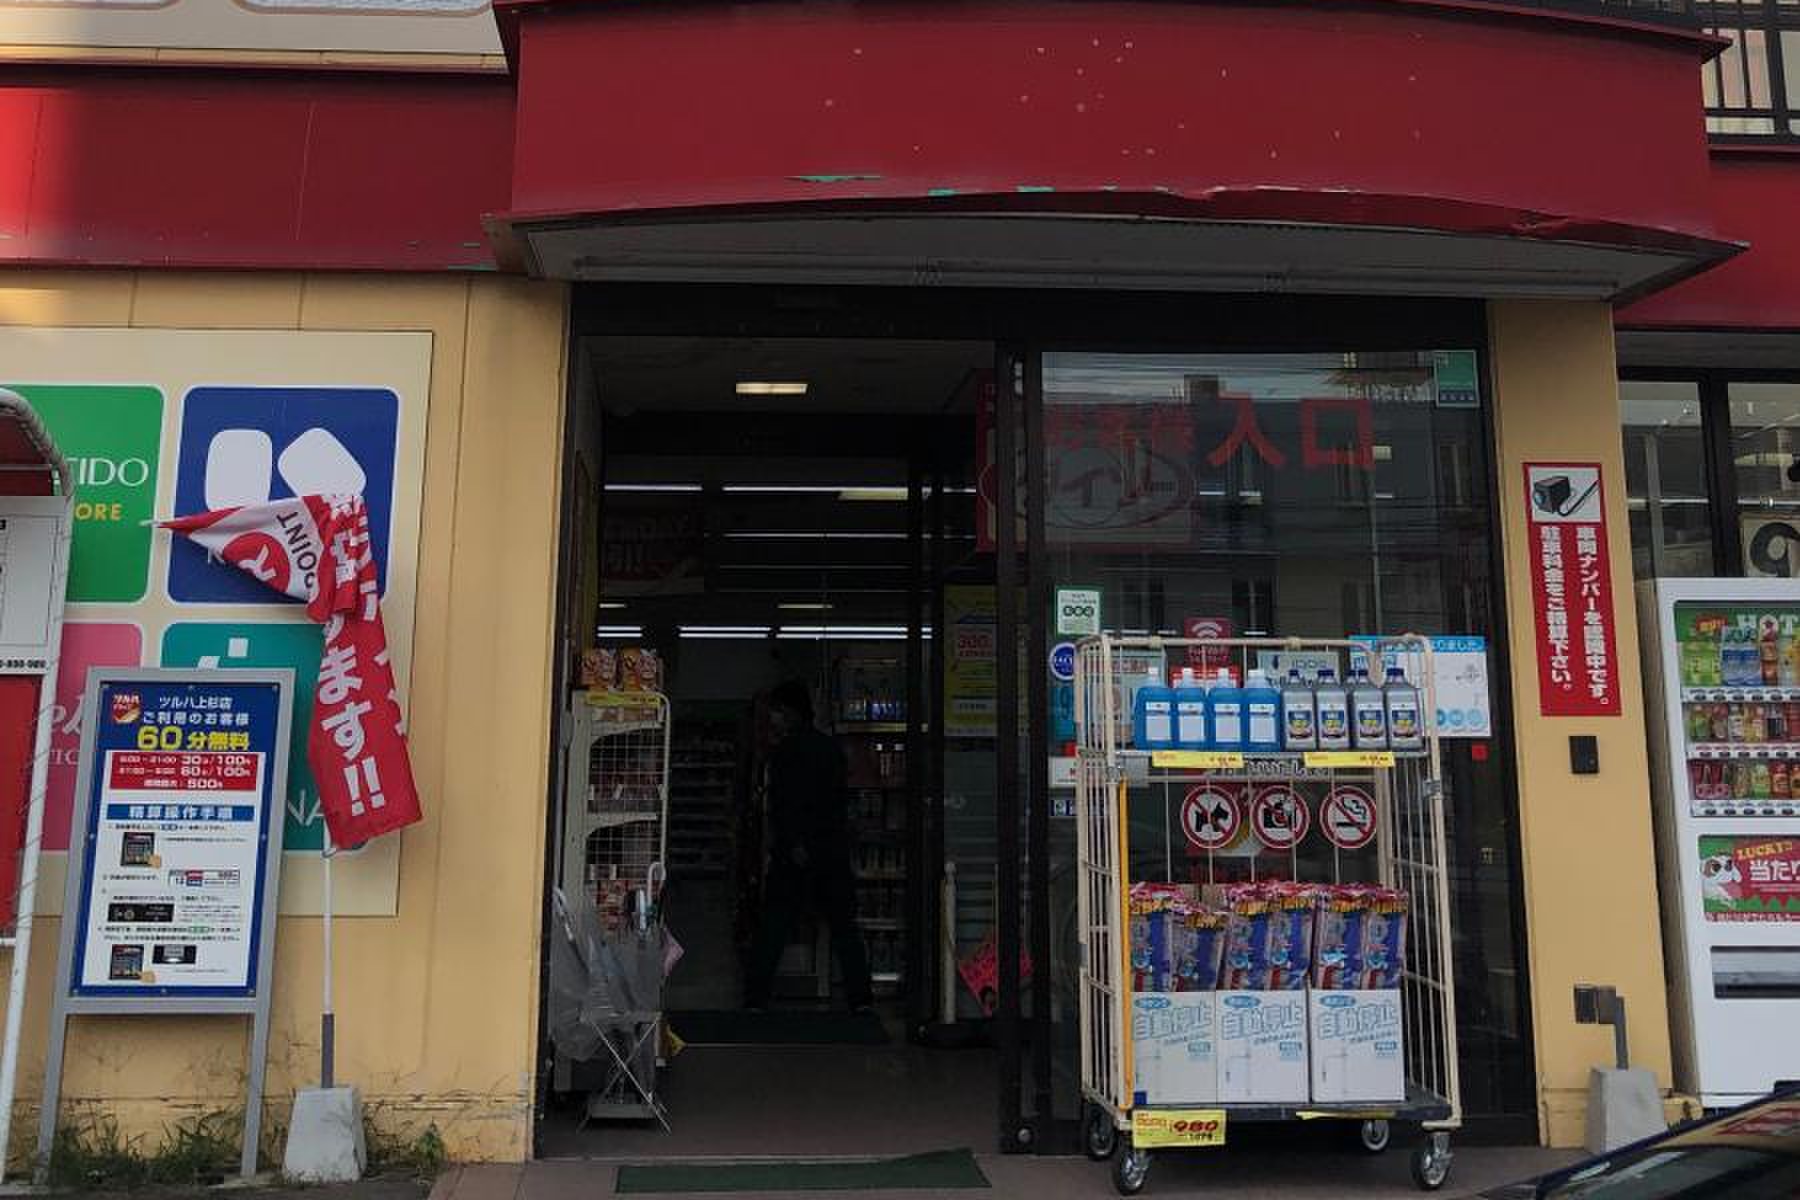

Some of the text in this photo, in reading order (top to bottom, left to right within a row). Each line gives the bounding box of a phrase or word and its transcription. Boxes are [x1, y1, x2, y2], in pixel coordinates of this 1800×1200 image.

[65, 457, 149, 487] IDO
[75, 502, 122, 521] ORE
[143, 711, 250, 726] ご利用のお客様
[137, 725, 250, 751] 60分無料
